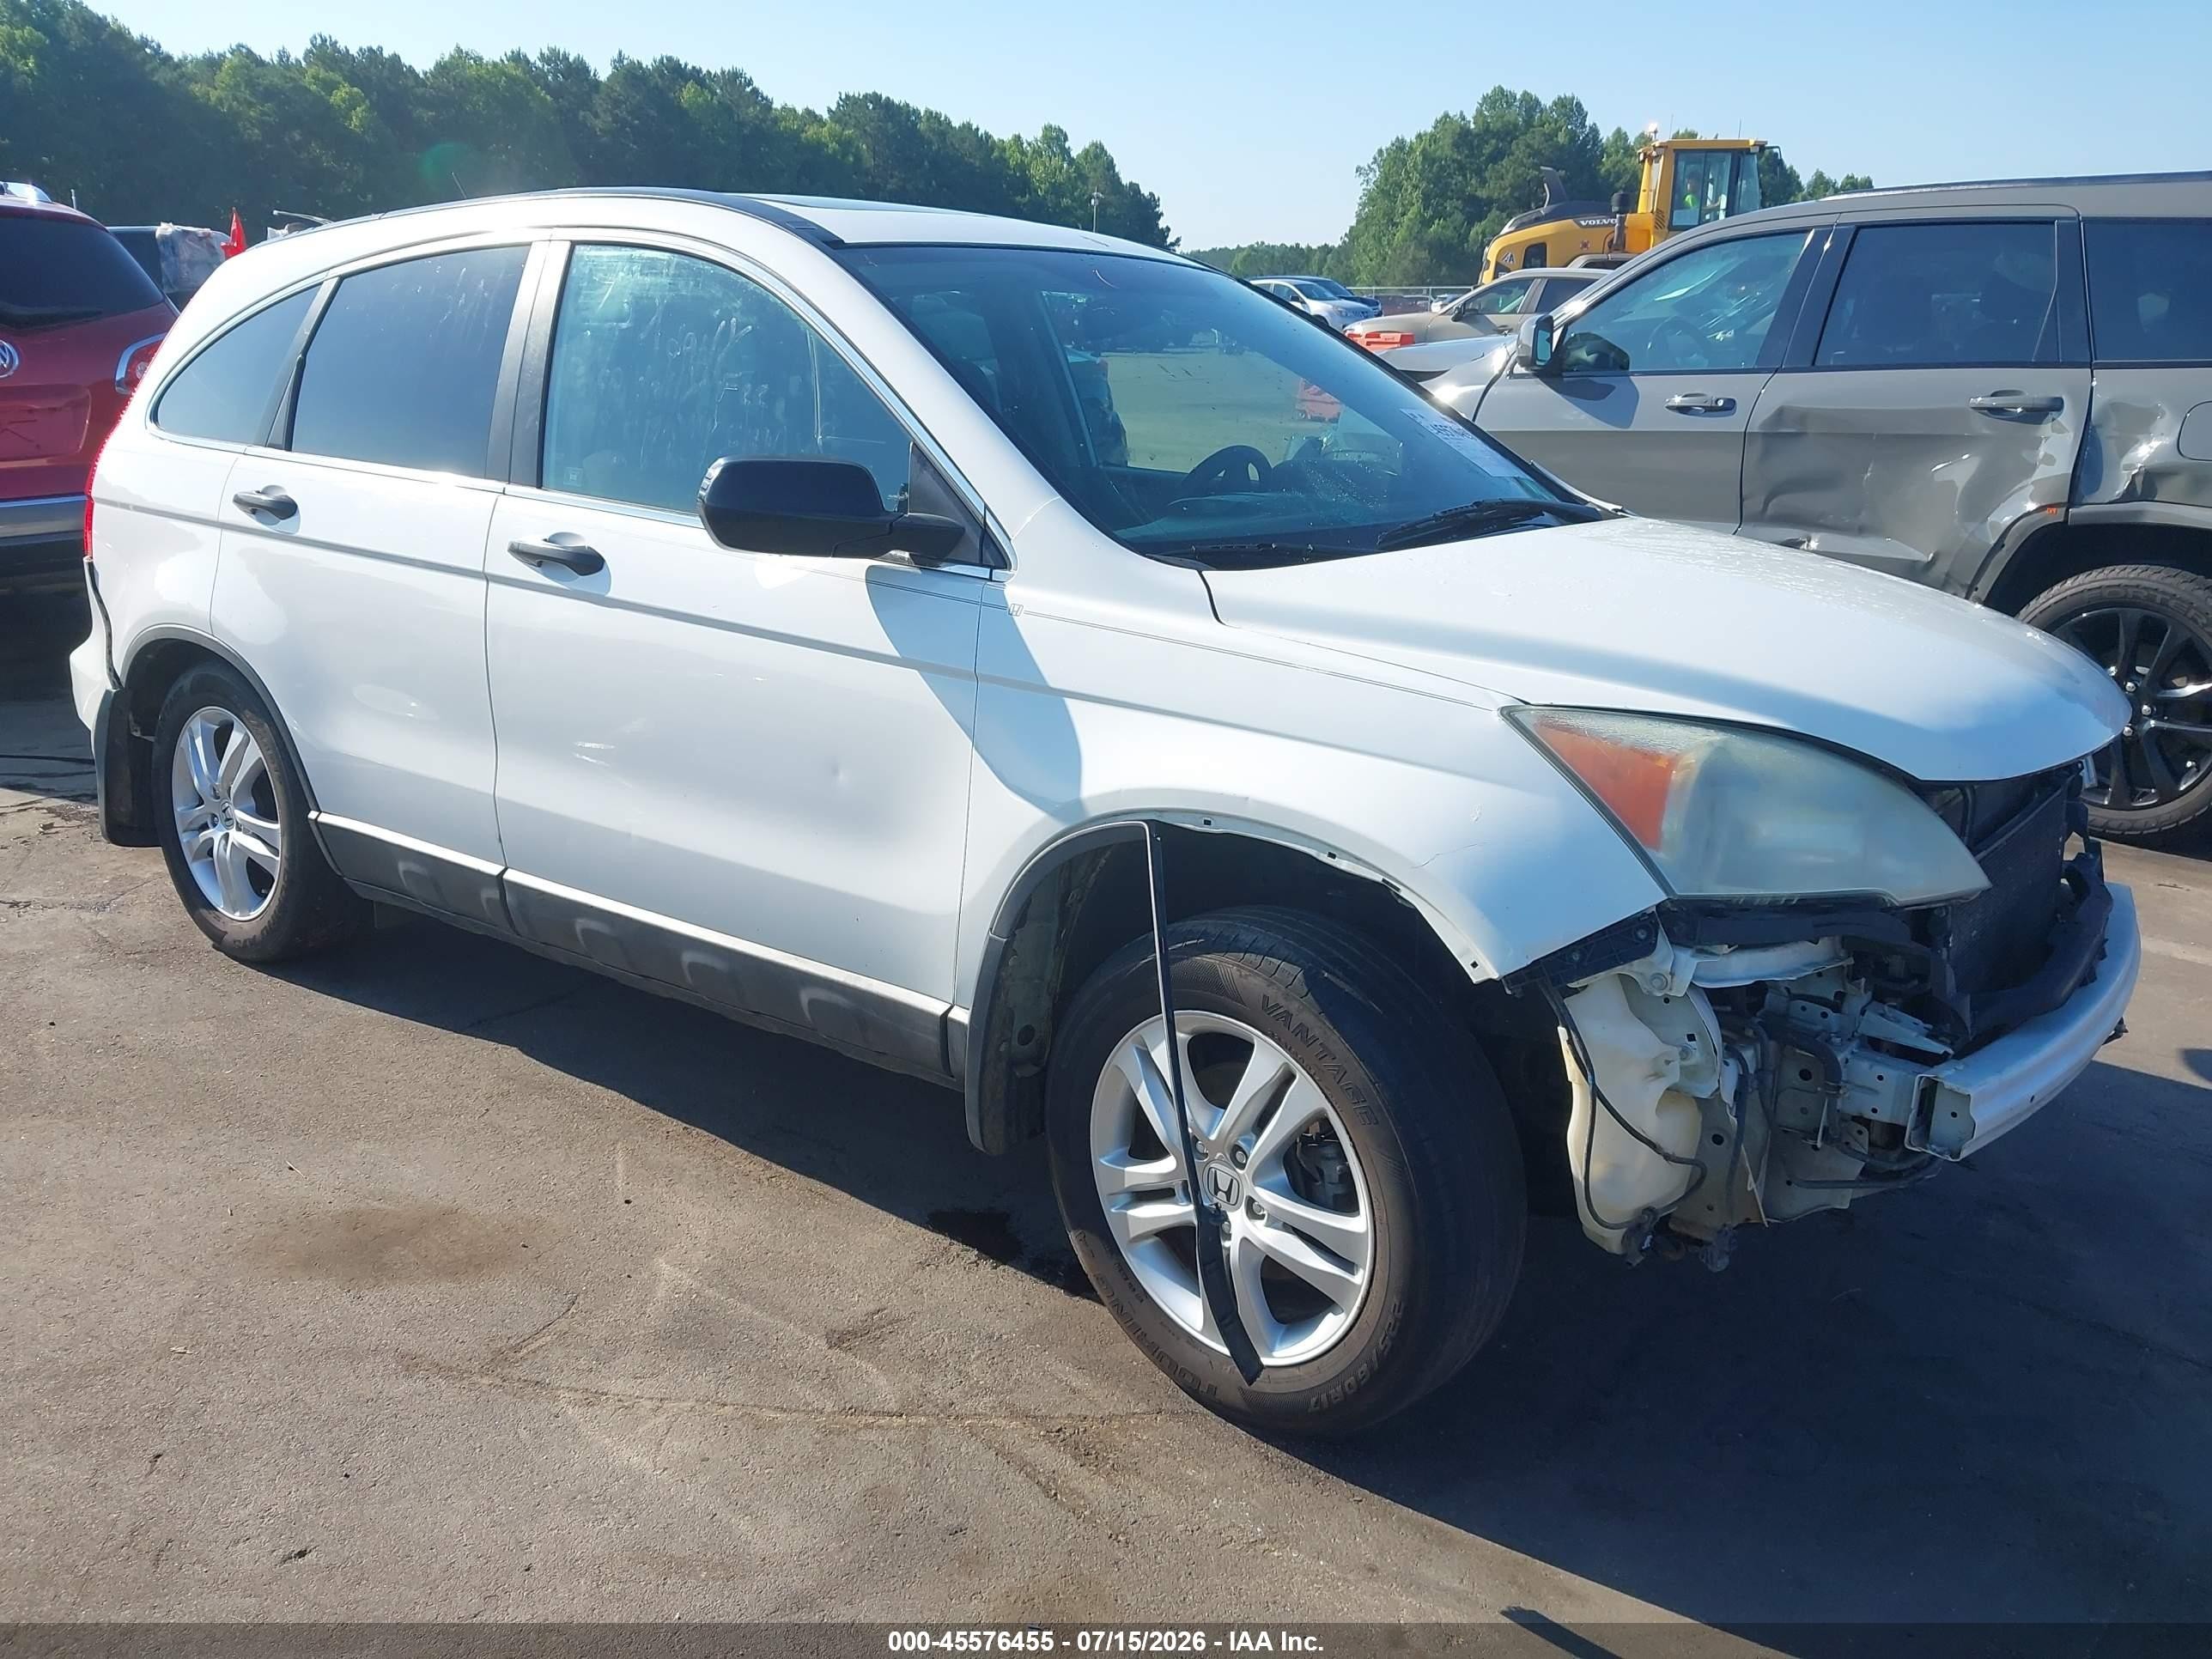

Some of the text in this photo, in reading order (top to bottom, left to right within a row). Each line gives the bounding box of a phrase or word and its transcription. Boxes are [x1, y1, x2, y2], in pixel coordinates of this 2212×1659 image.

[1579, 217, 1618, 227] VOLVO
[2087, 587, 2212, 635] FORTER
[1261, 994, 1380, 1127] VANTAGE
